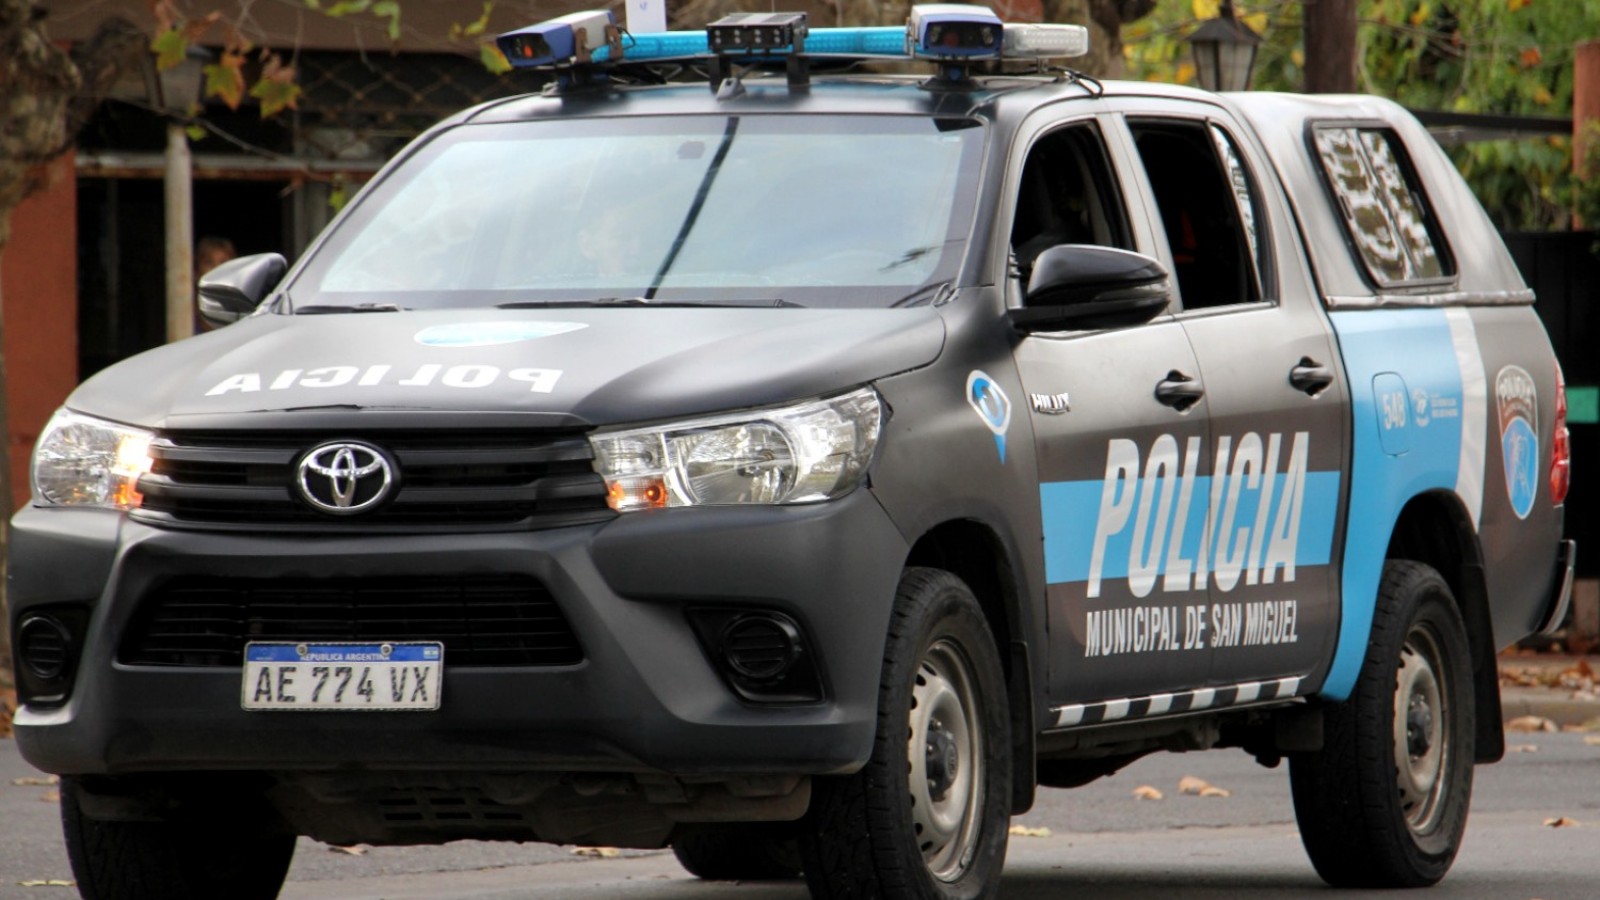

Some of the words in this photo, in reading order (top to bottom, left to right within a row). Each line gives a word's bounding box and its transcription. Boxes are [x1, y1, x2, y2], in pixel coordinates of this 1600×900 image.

[1086, 431, 1309, 599] POLICIA
[1085, 606, 1180, 658] MUNICIPAL
[1184, 605, 1206, 650] DE
[1211, 603, 1242, 648] SAN
[1243, 600, 1298, 646] MIGUEL
[254, 666, 297, 702] AE
[312, 666, 375, 703] 774
[390, 666, 430, 703] VX
